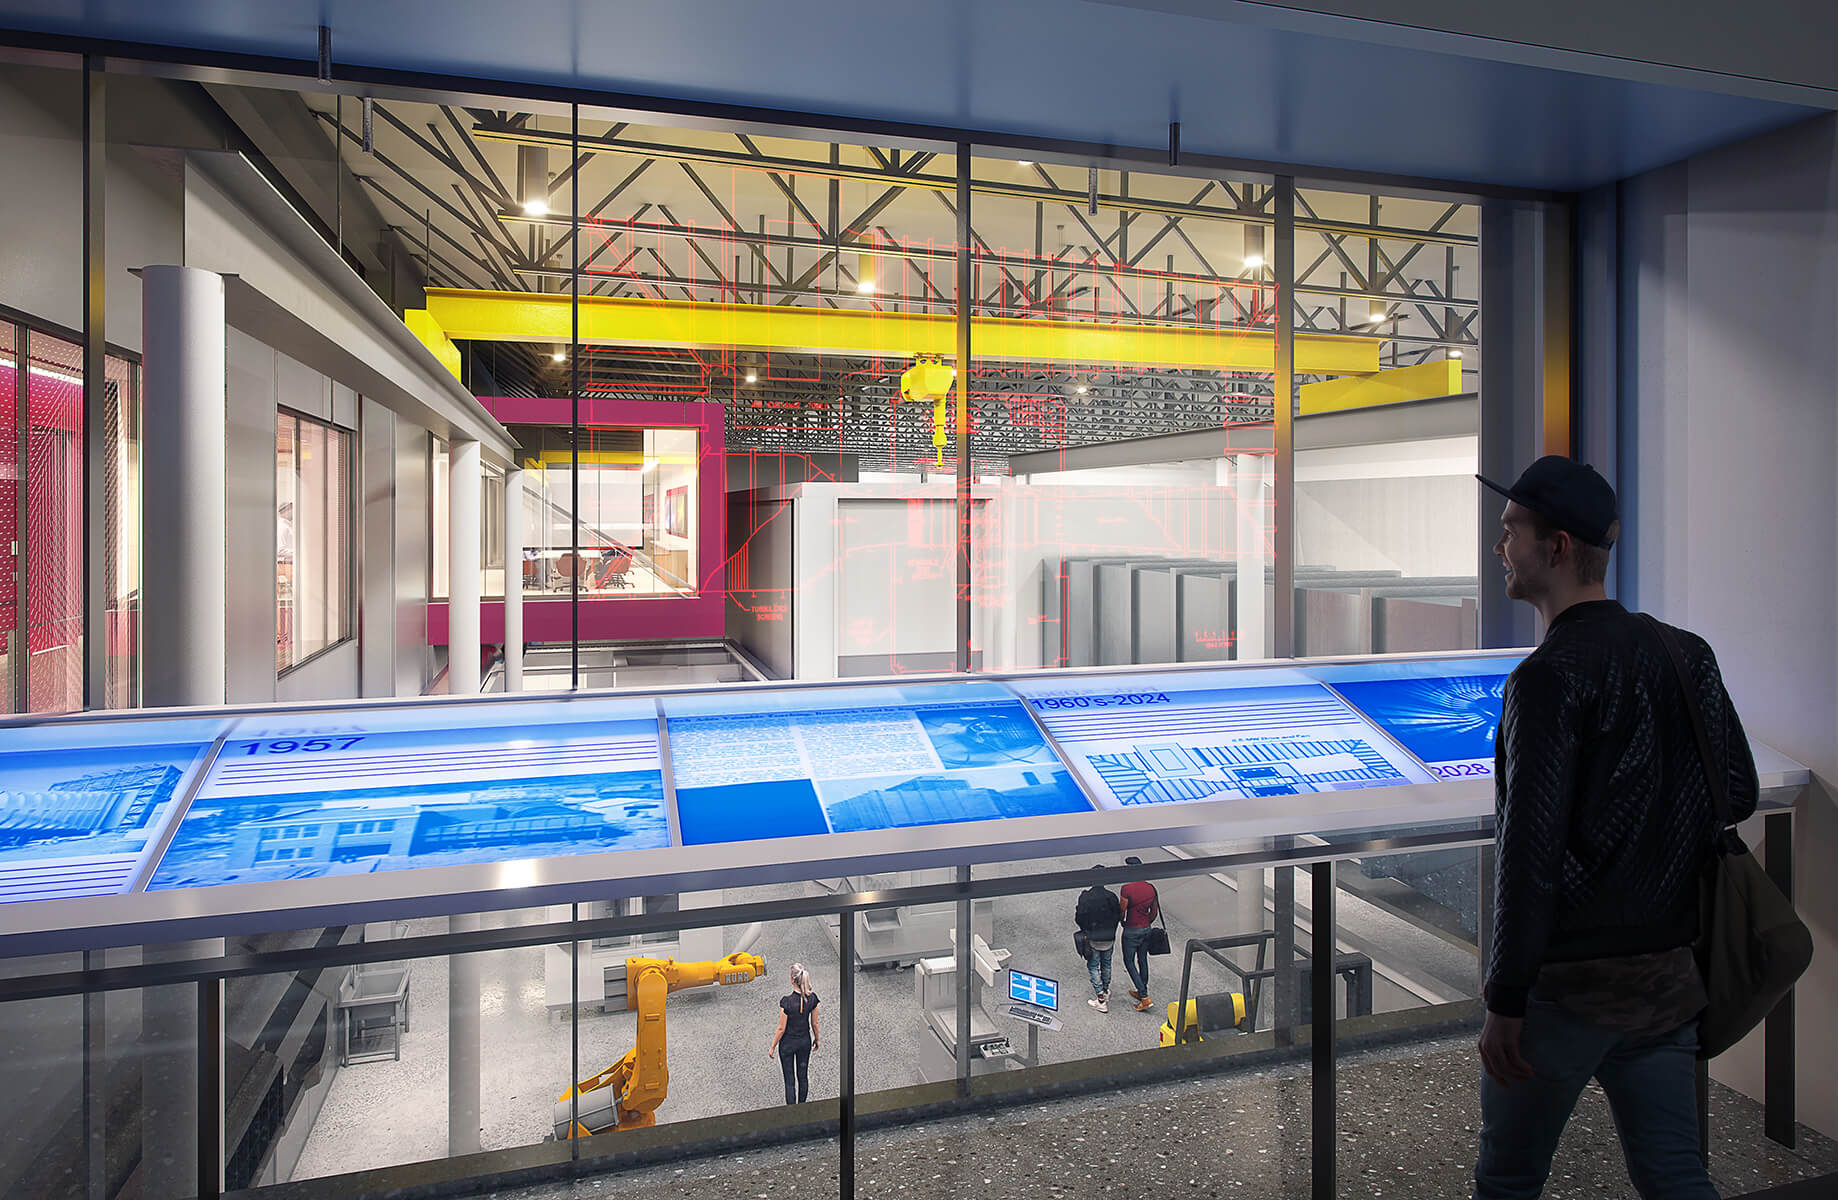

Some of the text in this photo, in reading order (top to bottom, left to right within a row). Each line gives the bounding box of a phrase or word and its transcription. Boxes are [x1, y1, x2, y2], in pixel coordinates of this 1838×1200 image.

[768, 401, 800, 409] EXCHANGE
[1032, 693, 1171, 710] 1960's-2024
[239, 736, 366, 756] 1957
[1431, 763, 1491, 778] 2028
